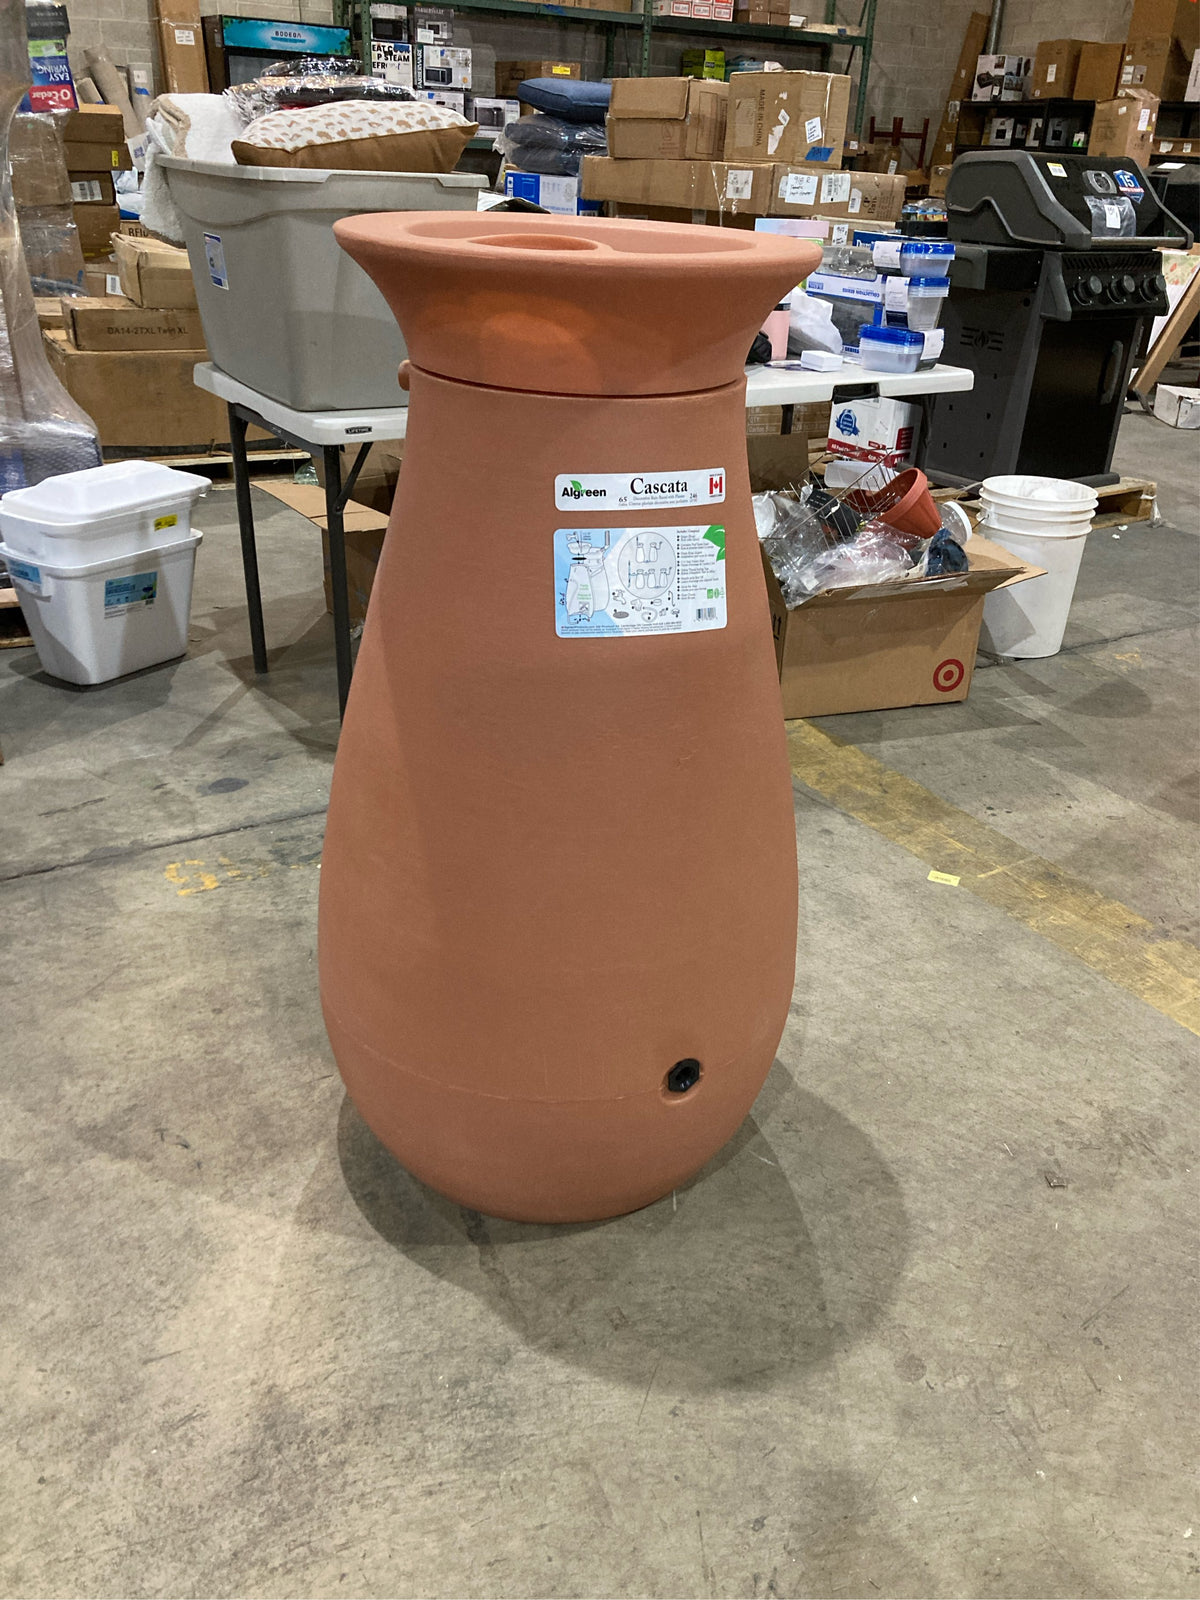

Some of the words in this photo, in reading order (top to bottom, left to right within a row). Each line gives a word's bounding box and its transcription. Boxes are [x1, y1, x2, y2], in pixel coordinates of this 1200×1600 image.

[384, 54, 410, 62] STEAM
[49, 73, 70, 81] EASY
[758, 89, 766, 112] MADE
[758, 113, 764, 121] IN
[755, 122, 763, 147] CHINA
[1119, 175, 1135, 188] 15
[630, 477, 688, 495] Cascata
[561, 487, 607, 500] Algreen
